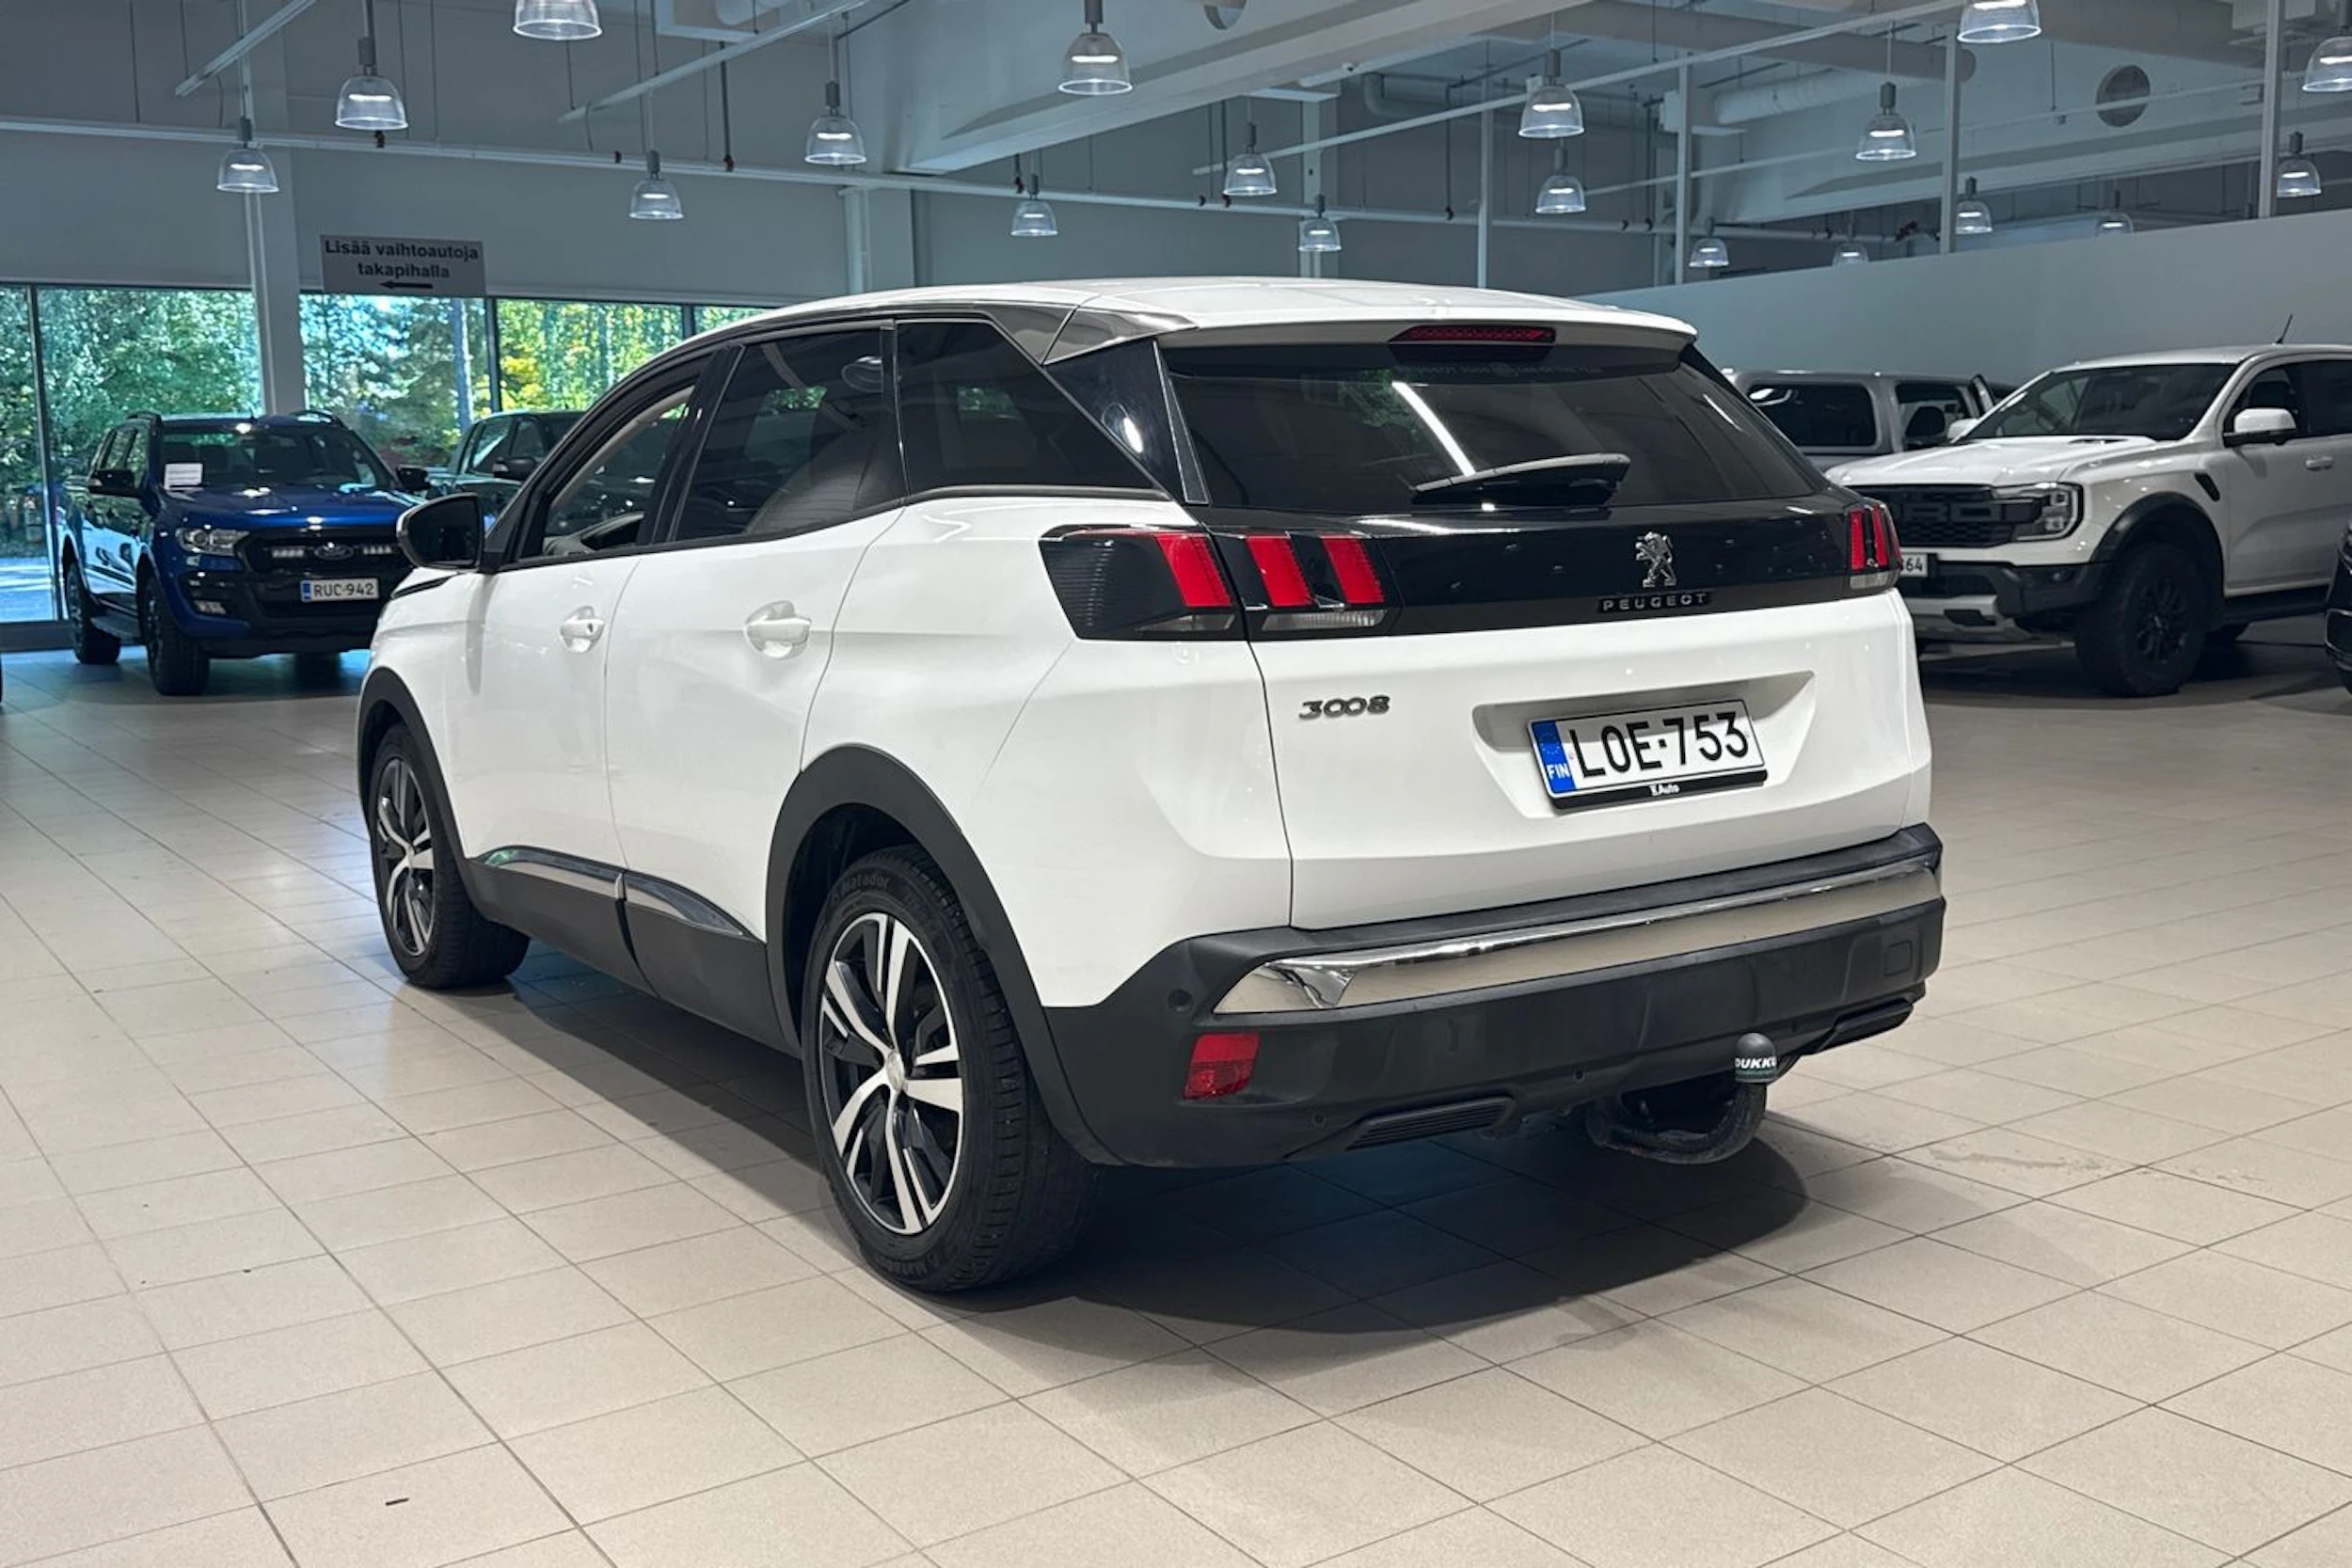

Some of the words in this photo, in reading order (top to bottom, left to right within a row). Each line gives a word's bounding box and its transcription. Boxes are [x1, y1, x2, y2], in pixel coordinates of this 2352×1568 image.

[326, 240, 371, 255] Lisää
[376, 243, 479, 261] vaihtoautoja
[358, 262, 451, 278] takapihalla
[313, 582, 373, 596] RUC-942
[1603, 593, 1707, 611] PEUGEOT
[1298, 695, 1390, 720] 3008
[1569, 711, 1750, 778] LOE-753
[1547, 763, 1571, 780] FIN
